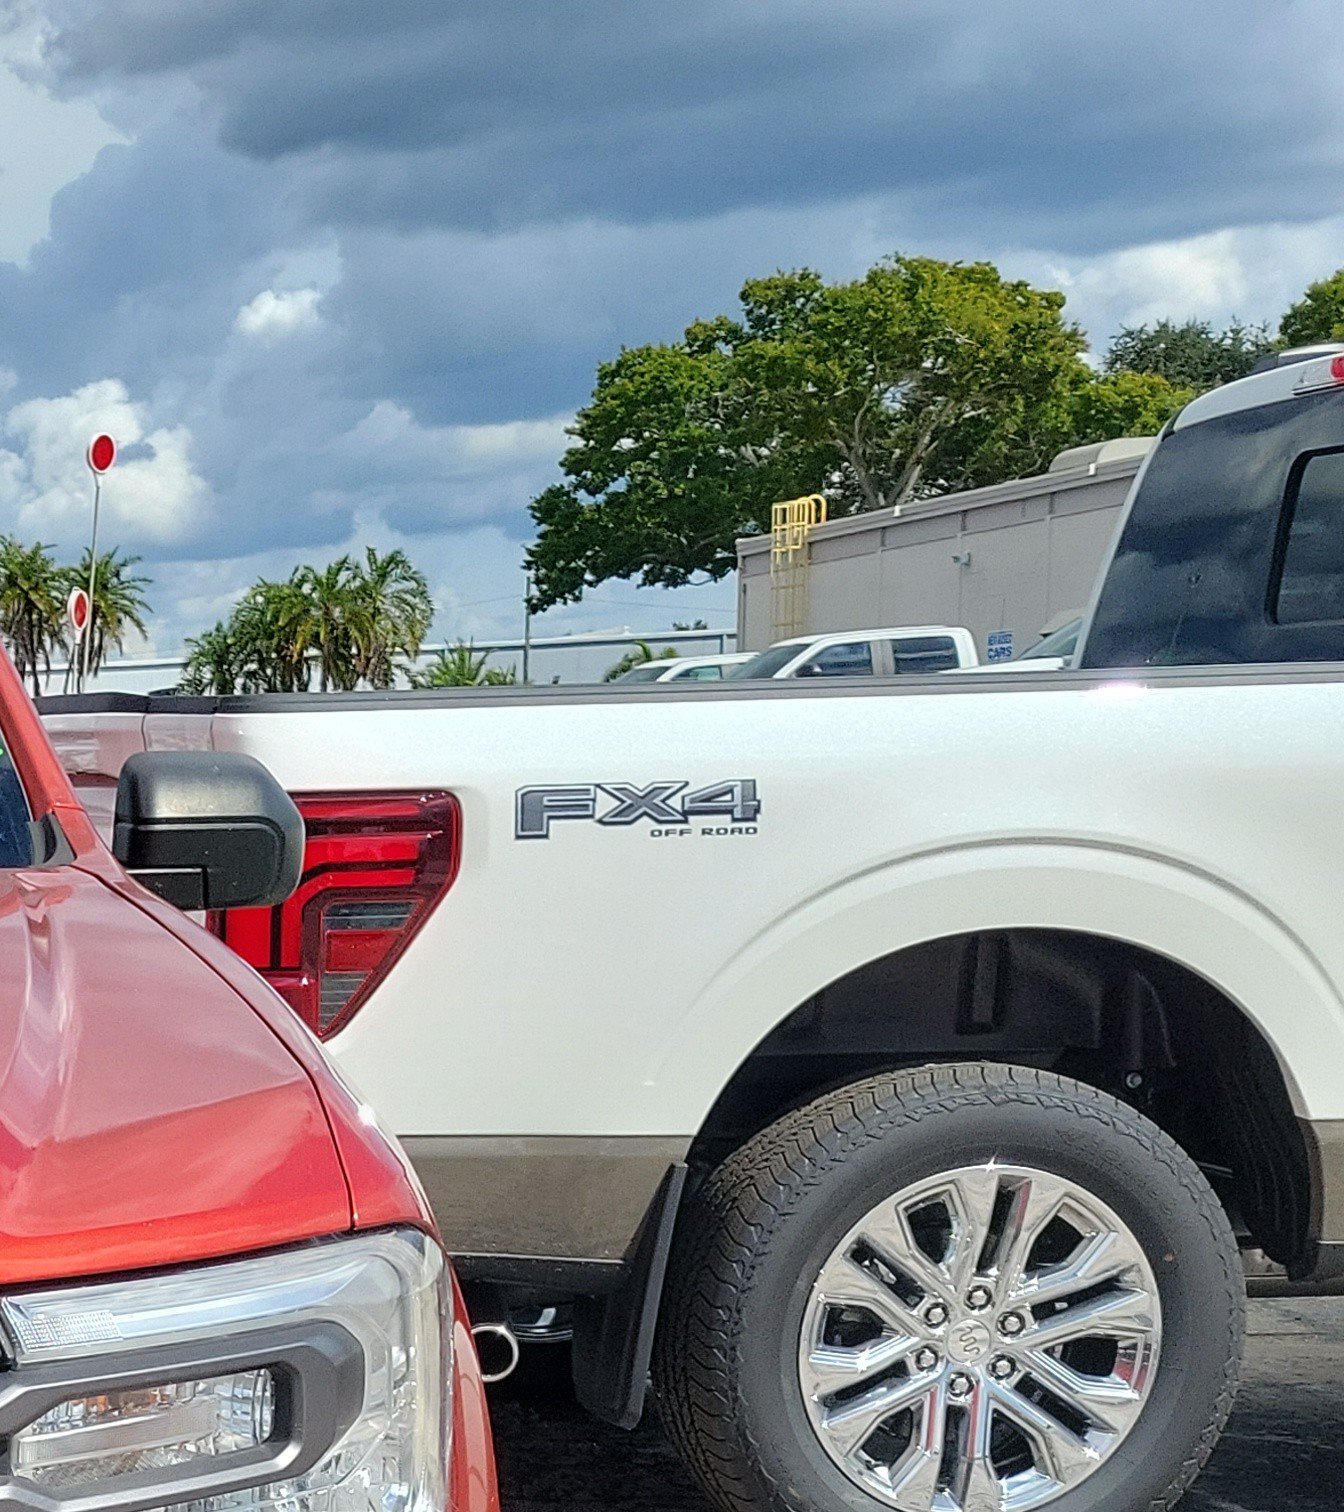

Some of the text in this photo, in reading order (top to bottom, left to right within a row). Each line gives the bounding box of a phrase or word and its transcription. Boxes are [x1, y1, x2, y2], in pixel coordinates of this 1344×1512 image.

[514, 779, 761, 840] FX4
[650, 826, 758, 838] OFF ROAD
